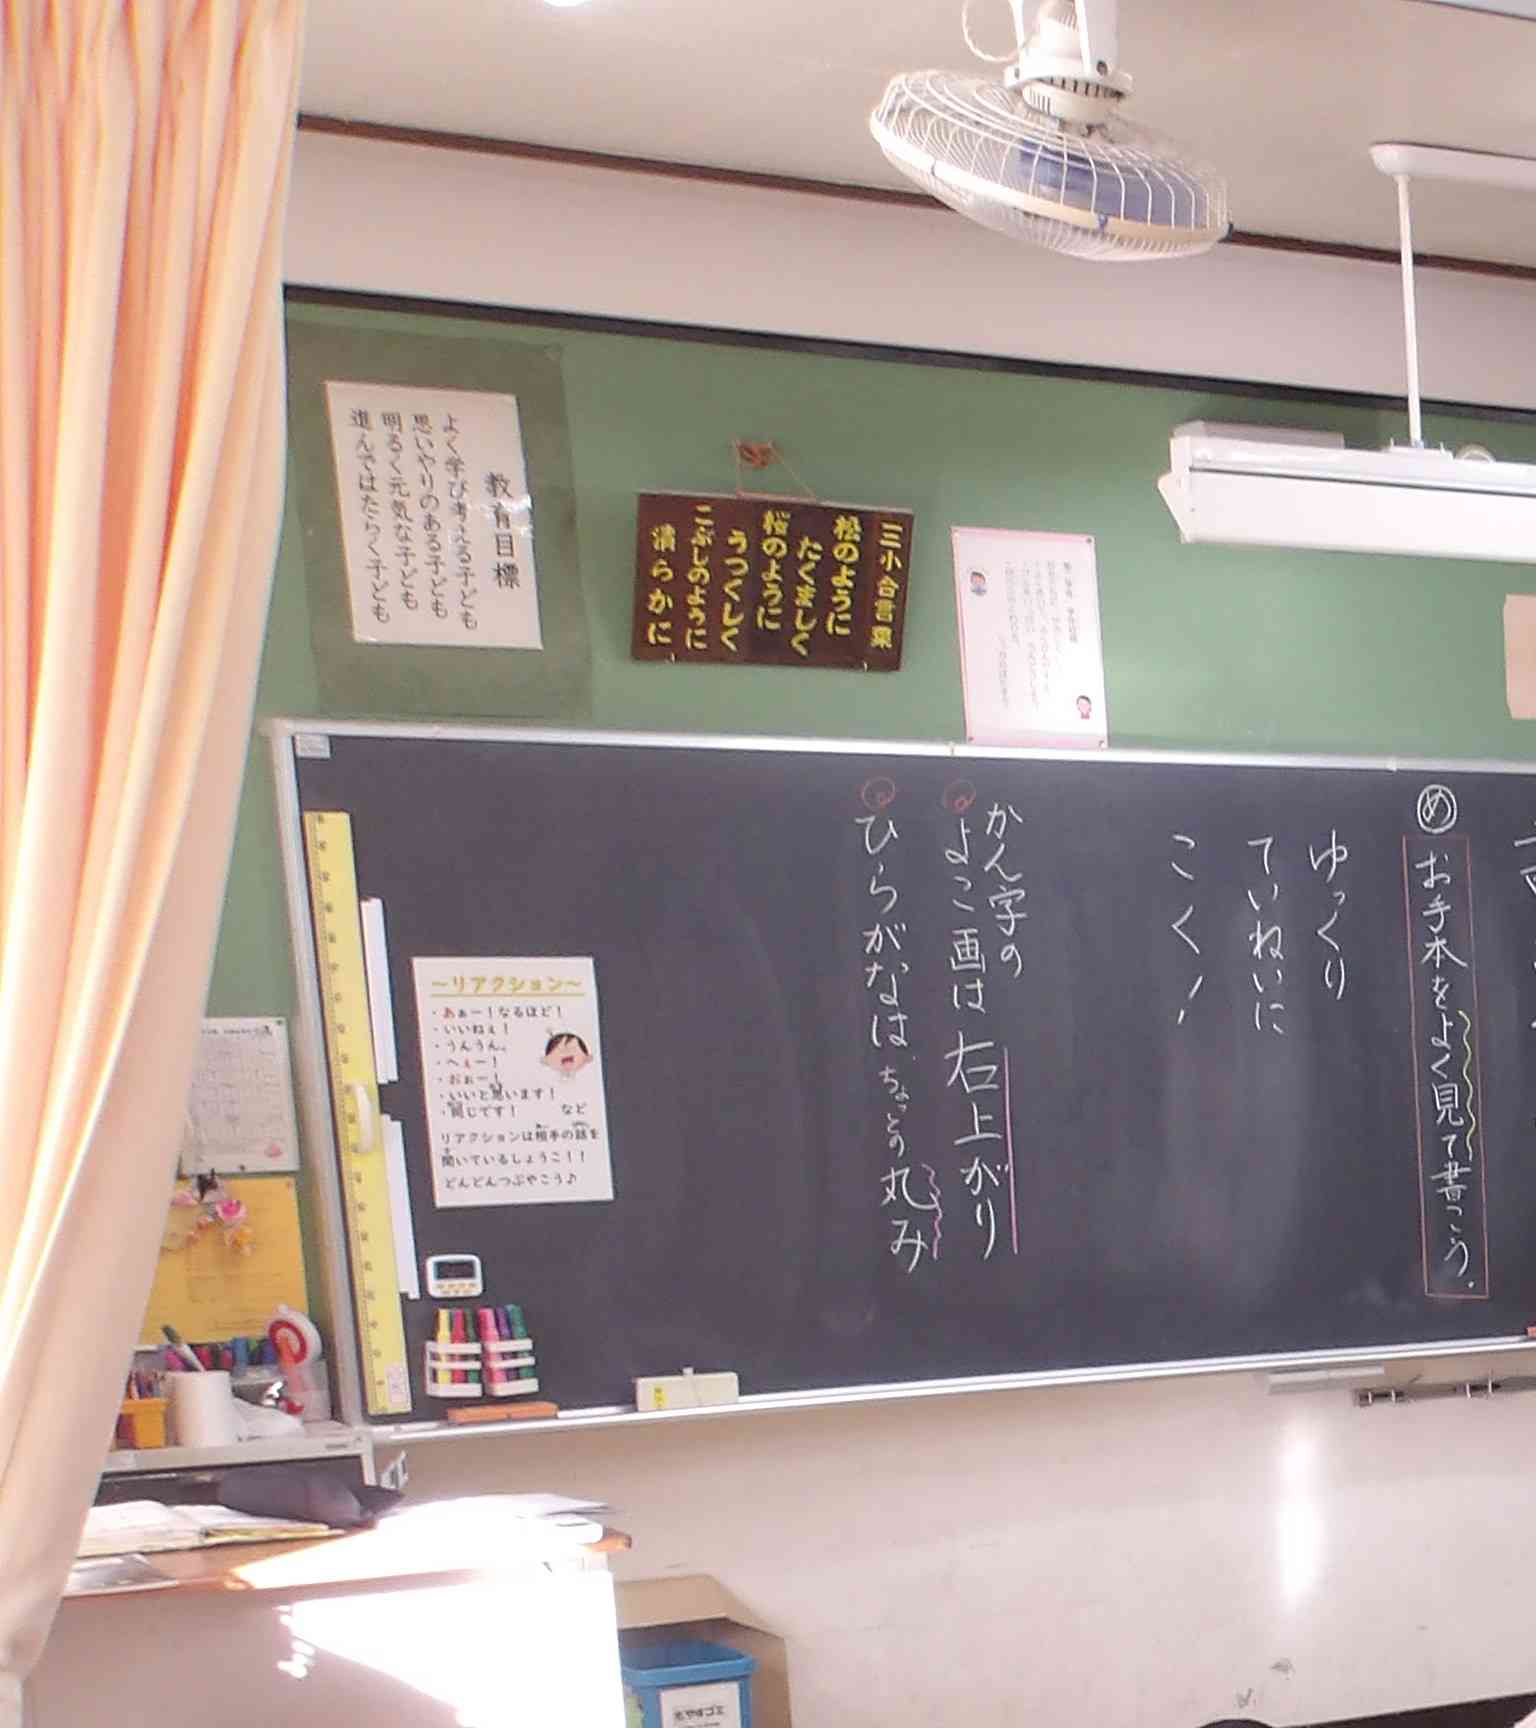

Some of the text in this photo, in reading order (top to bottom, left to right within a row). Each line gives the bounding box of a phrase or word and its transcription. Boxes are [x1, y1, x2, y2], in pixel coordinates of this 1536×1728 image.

[685, 503, 715, 650] こぶしのように
[720, 528, 750, 652] うつくしく
[756, 509, 791, 631] 桜のように
[791, 536, 823, 657] たくましく
[827, 515, 862, 637] 松のように
[983, 801, 1027, 978] かん字の
[1245, 834, 1285, 1035] ていねいに
[1308, 832, 1350, 1000] ゆっくり
